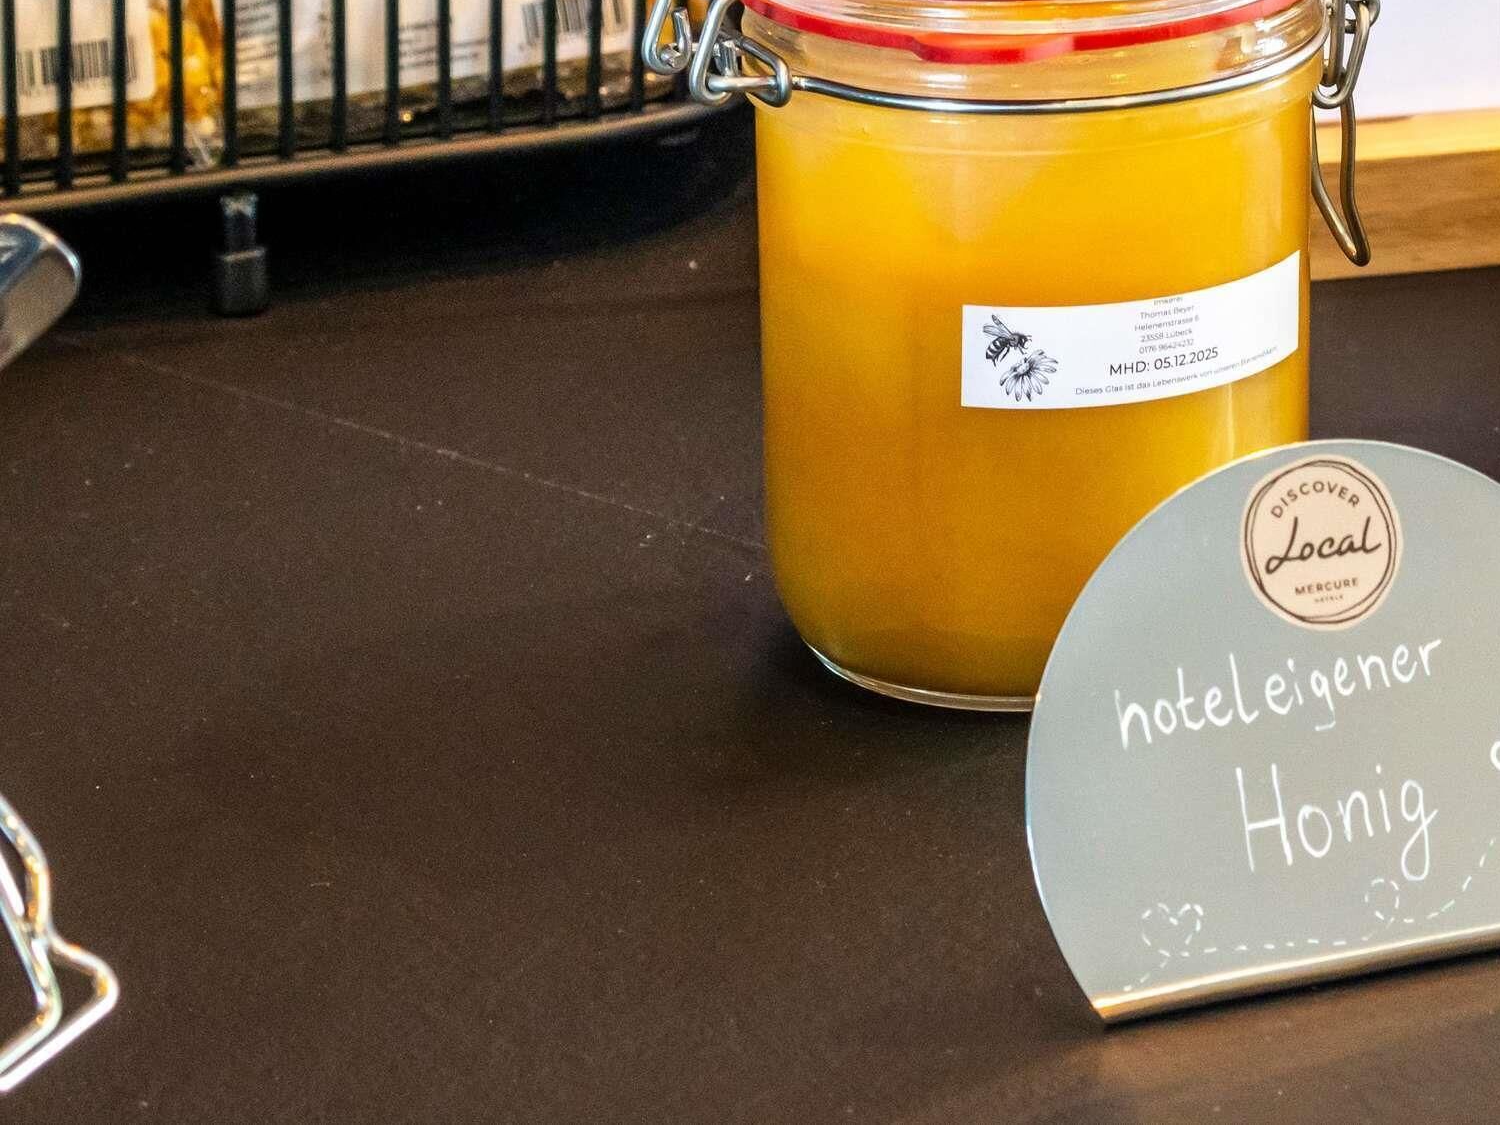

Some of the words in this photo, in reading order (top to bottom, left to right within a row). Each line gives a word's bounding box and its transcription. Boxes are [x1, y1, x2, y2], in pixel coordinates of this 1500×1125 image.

[1109, 361, 1150, 376] MHD:
[1154, 346, 1219, 371] 05.12.2025
[1139, 344, 1157, 355] 0176
[1075, 386, 1104, 396] Dieses
[1105, 384, 1123, 393] Glas
[1125, 382, 1135, 391] ist
[1136, 380, 1151, 391] das
[1152, 373, 1198, 388] Lebenswerk
[1271, 480, 1360, 519] DISCOVER
[1265, 516, 1381, 574] Local
[1294, 577, 1359, 596] MERCURE
[1114, 640, 1443, 749] hoteleigener
[1235, 764, 1439, 882] Honig
